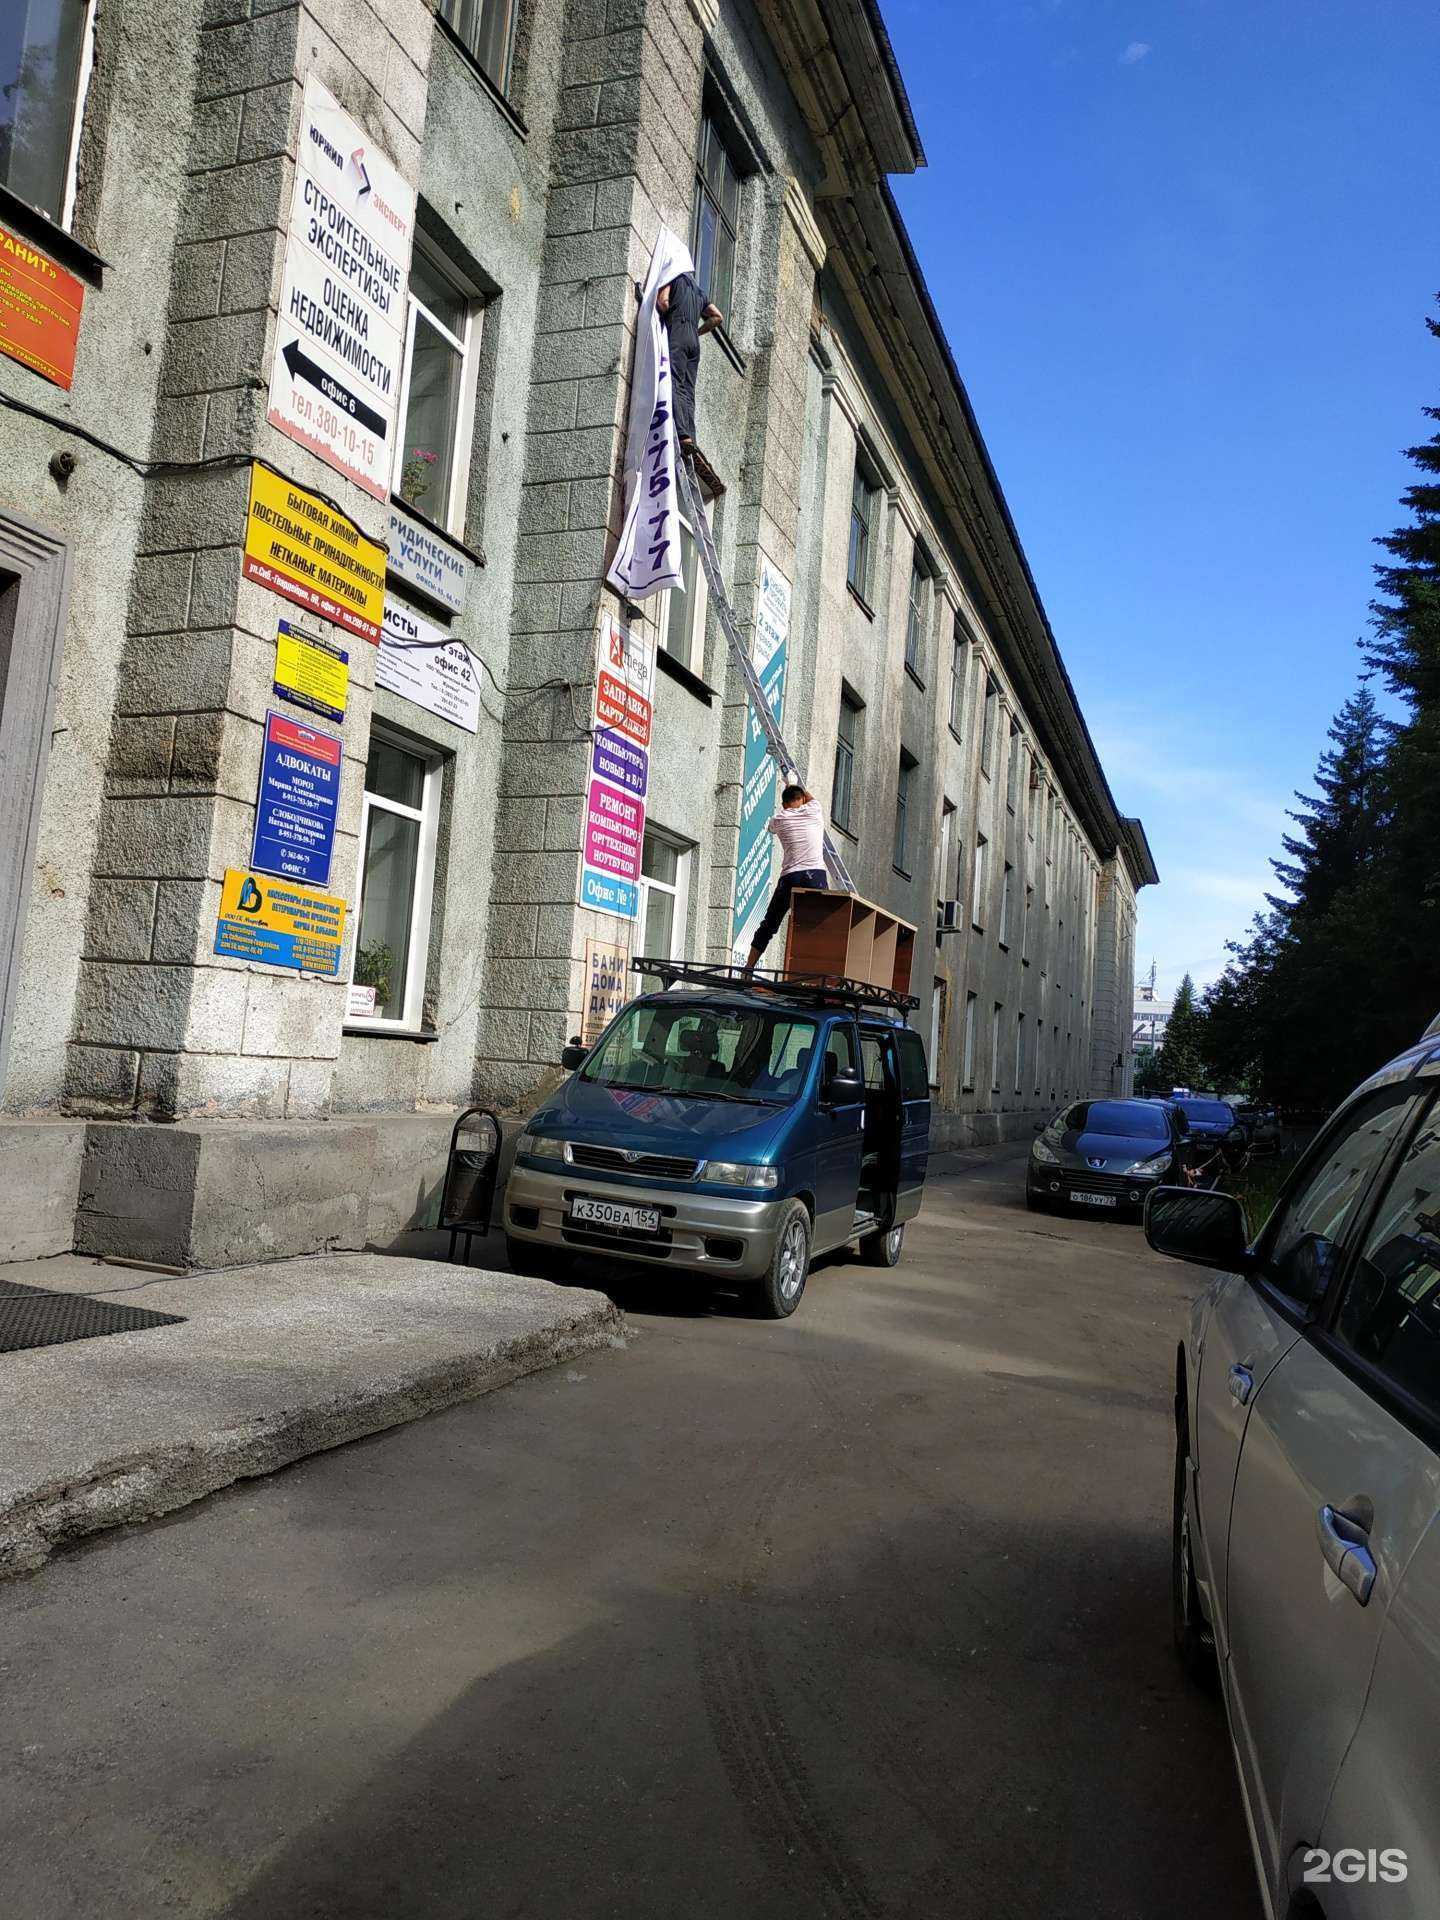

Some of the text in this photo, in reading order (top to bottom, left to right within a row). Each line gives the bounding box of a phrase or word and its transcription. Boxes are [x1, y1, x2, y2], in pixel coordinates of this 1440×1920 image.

[309, 124, 344, 171] ЮРЖИЛ
[373, 194, 408, 236] ЭКСПЕРТ
[304, 179, 401, 292] СТРОИТЕЛЬНЫЕ
[0, 232, 57, 279] АНИТ»
[308, 217, 390, 314] ЭКСПЕРТИЗЫ
[323, 278, 369, 341] ОЦЕНКА
[290, 286, 391, 394] НЕДВИЖИМОСТИ
[321, 377, 356, 415] офис 6
[291, 390, 375, 466] тел.380-10-15
[287, 492, 359, 547] БЫТОВАЯ ХИМИЯ
[252, 501, 384, 589] ПОСТЕЛЬНЫЕ ПРИНАДЛЕЖНОСТИ
[388, 515, 464, 578] РИДИЧЕСКИЕ
[400, 541, 442, 581] УСЛУГИ
[270, 541, 368, 606] НЕТКАНЫЕ МАТЕРИАЛЫ
[434, 655, 459, 675] офис
[460, 668, 471, 682] 42
[603, 679, 648, 721] ЗАПРАВКА
[275, 752, 331, 781] АДВОКАТЫ
[291, 776, 314, 791] МОРОЗ
[599, 756, 625, 779] НОВЫЕ
[272, 807, 324, 831] СЛОБОДЧИКОВА
[589, 811, 642, 843] КОМПЬЮТЕРОВ
[599, 793, 637, 823] РЕМОНТ
[281, 862, 301, 873] ОФИС
[593, 849, 634, 874] НОУТБУКОВ
[587, 878, 615, 904] Офис
[616, 887, 627, 906] №
[592, 952, 624, 973] БАНИ
[591, 973, 622, 992] ДОМА
[590, 996, 621, 1014] ДАЧИ
[634, 1210, 655, 1224] 154
